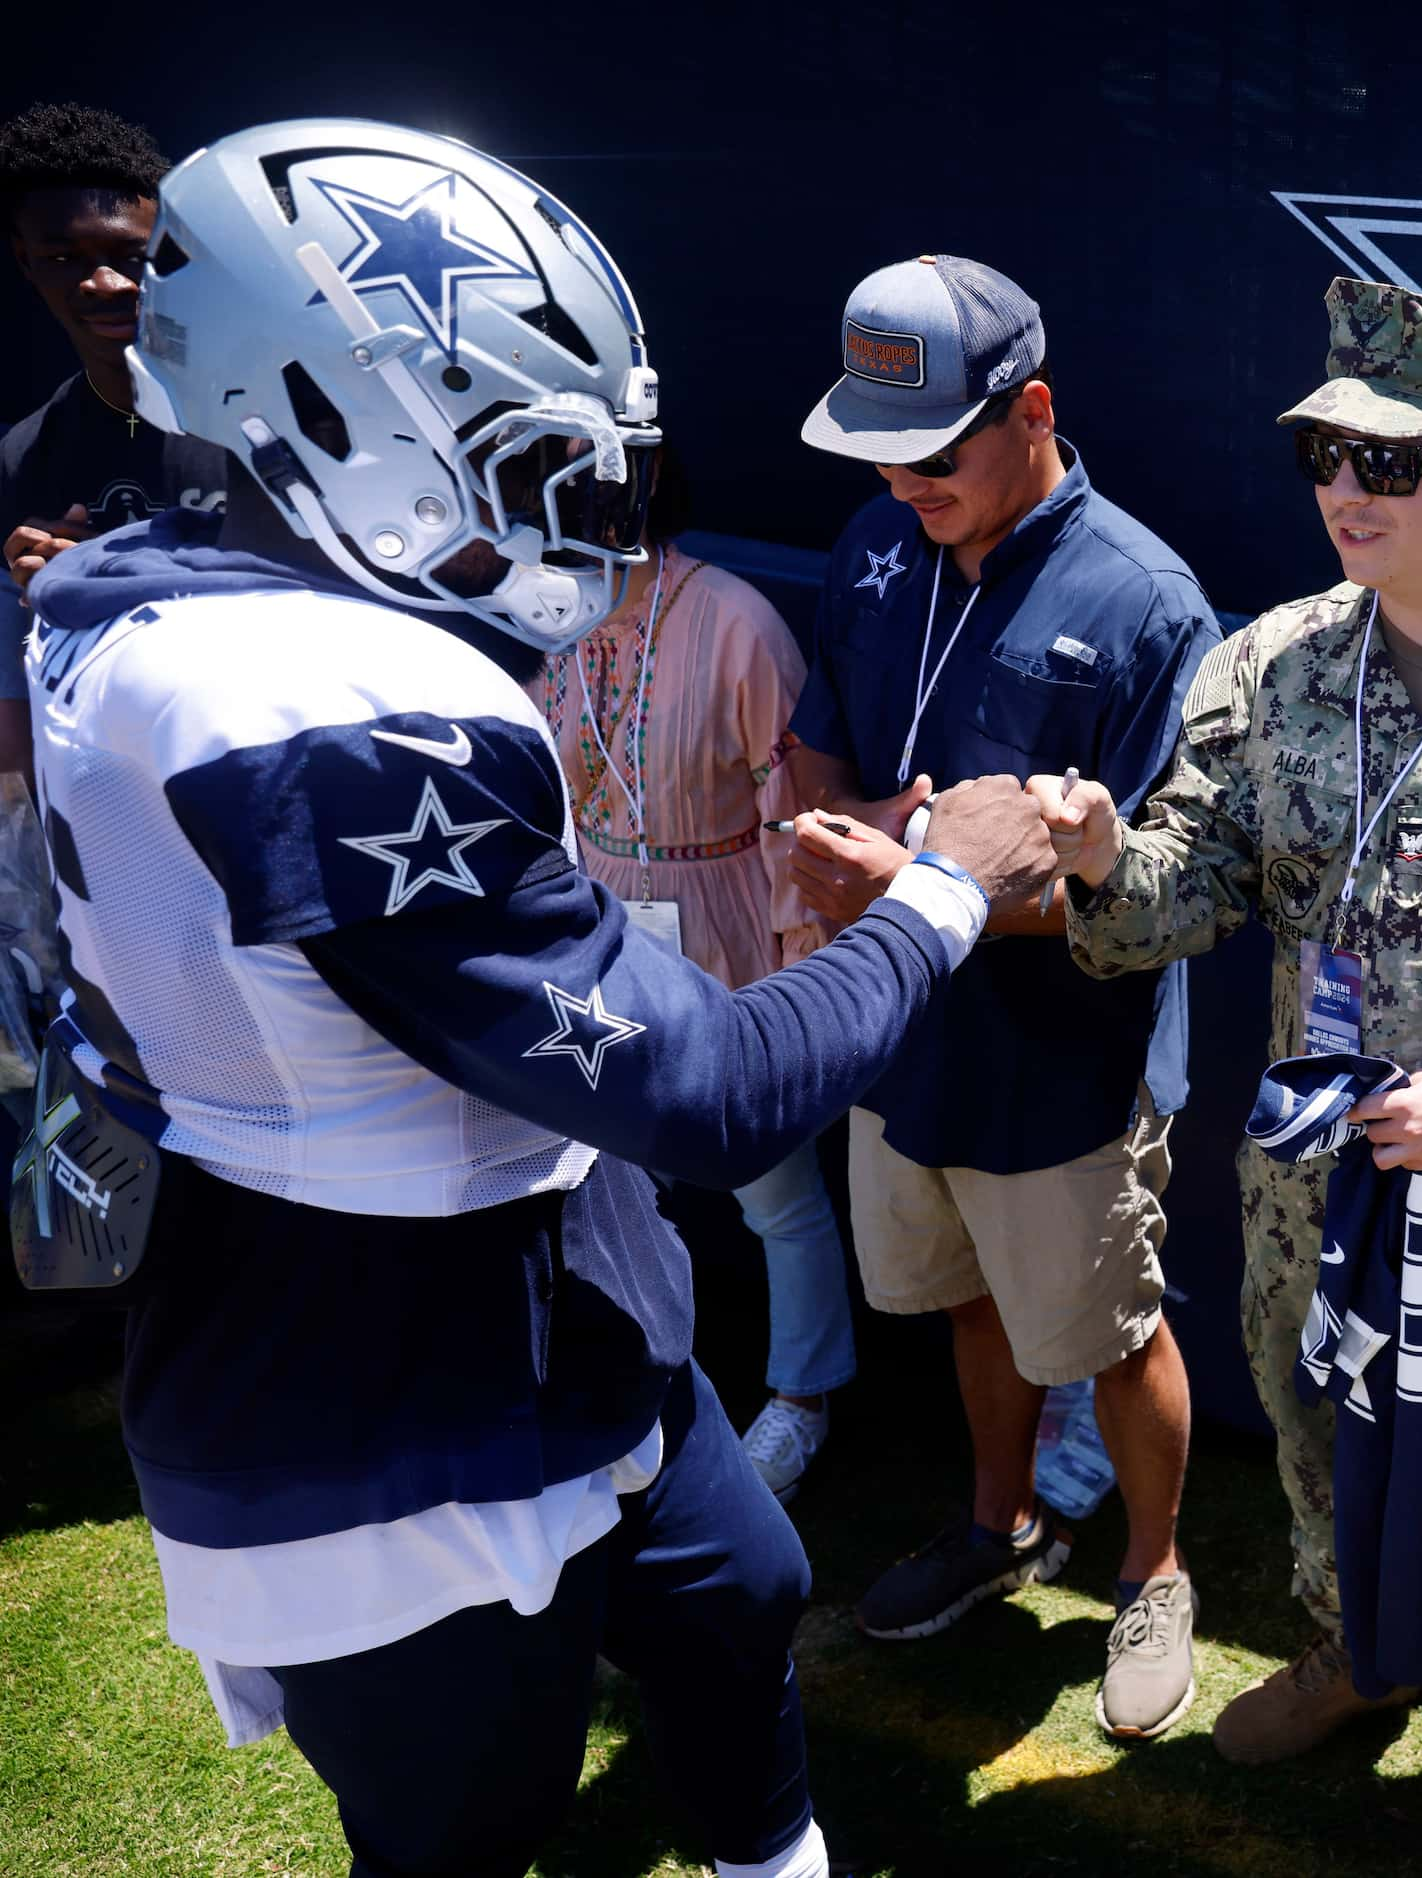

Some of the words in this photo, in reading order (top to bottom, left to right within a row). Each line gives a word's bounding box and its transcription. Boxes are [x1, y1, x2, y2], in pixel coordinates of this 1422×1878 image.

[876, 343, 917, 365] ROPES
[1272, 750, 1316, 780] ALBA
[1313, 976, 1351, 995] TRAINING
